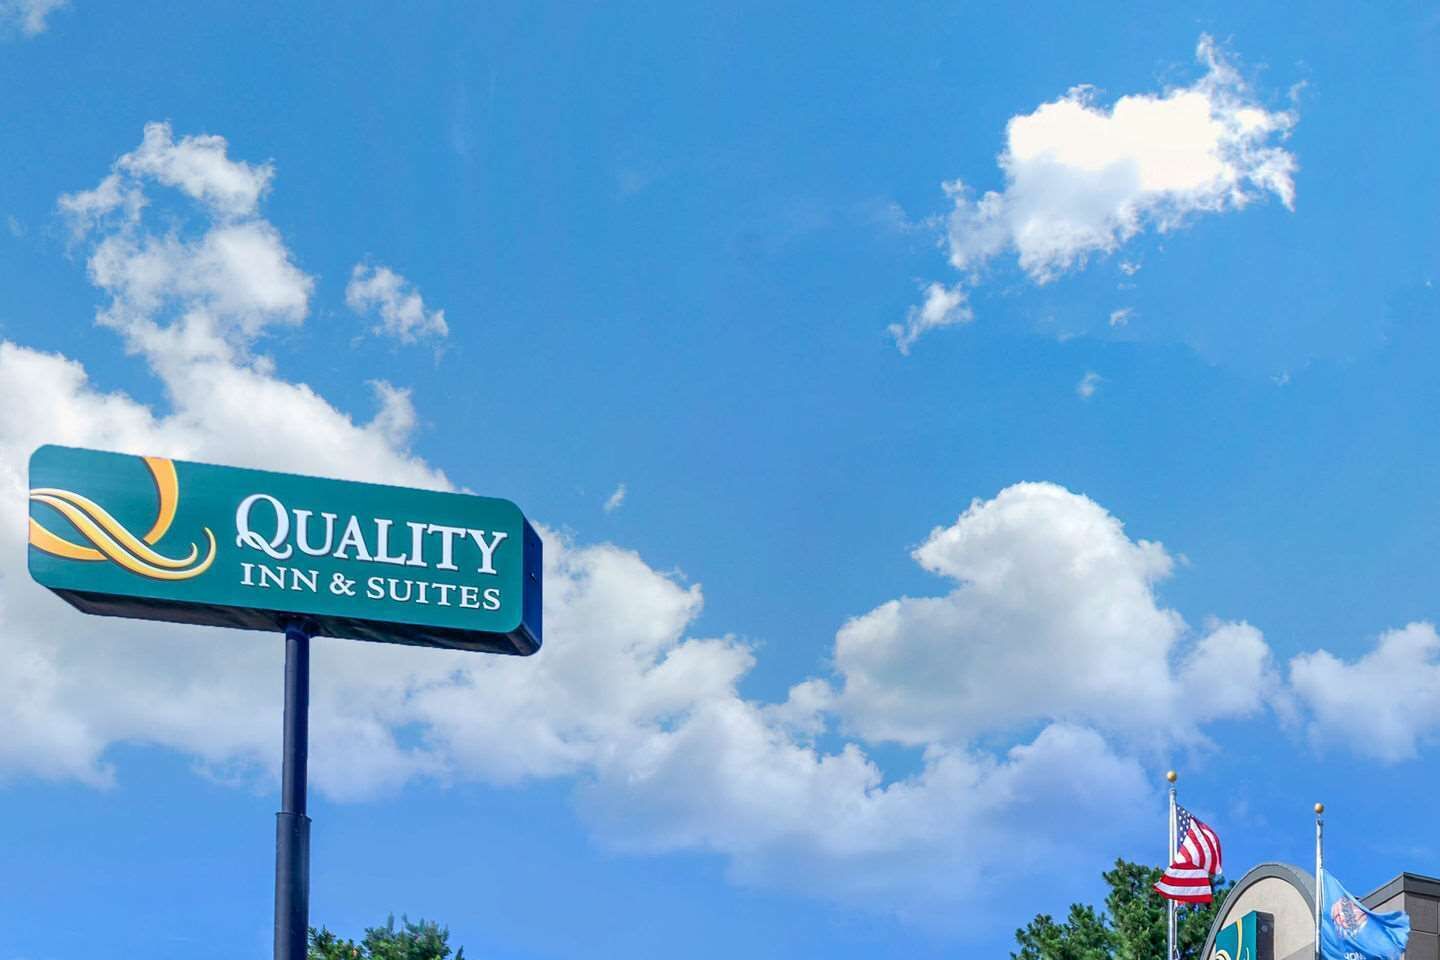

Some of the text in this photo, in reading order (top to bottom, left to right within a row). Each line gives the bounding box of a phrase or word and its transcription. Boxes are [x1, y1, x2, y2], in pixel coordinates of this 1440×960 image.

[236, 493, 508, 574] QUALITY
[240, 562, 501, 610] INN & SUITES
